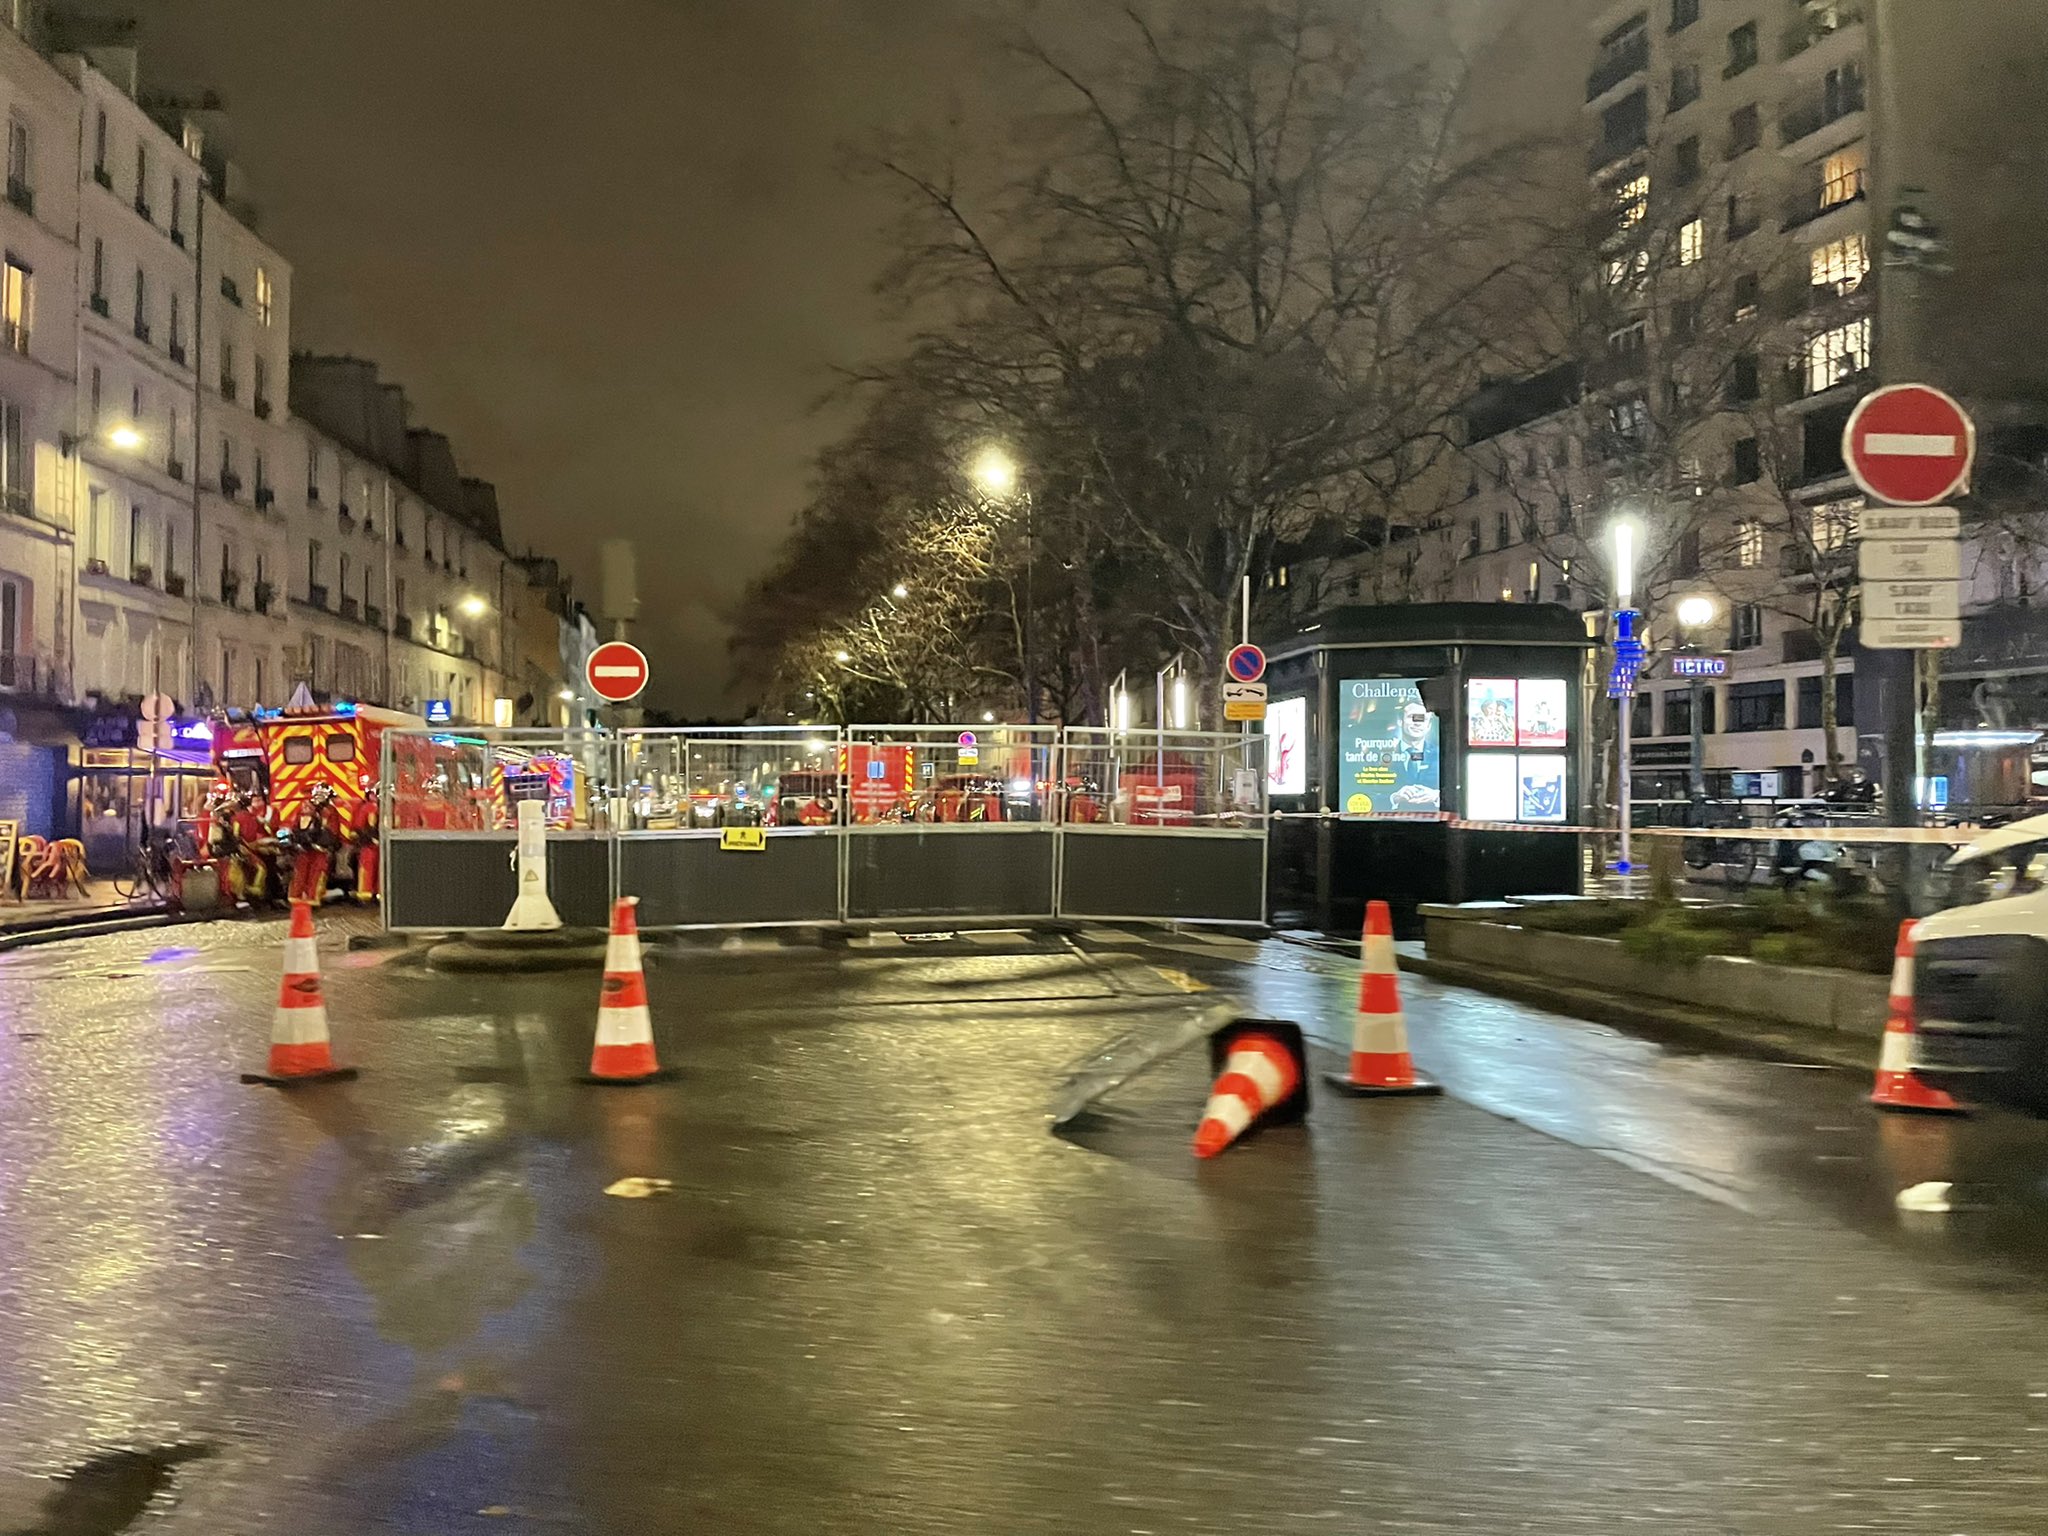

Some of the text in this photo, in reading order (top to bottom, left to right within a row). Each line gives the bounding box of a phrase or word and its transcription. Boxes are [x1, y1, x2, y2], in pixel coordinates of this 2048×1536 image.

[1352, 682, 1419, 701] Challeng
[1345, 751, 1406, 762] tant de ine
